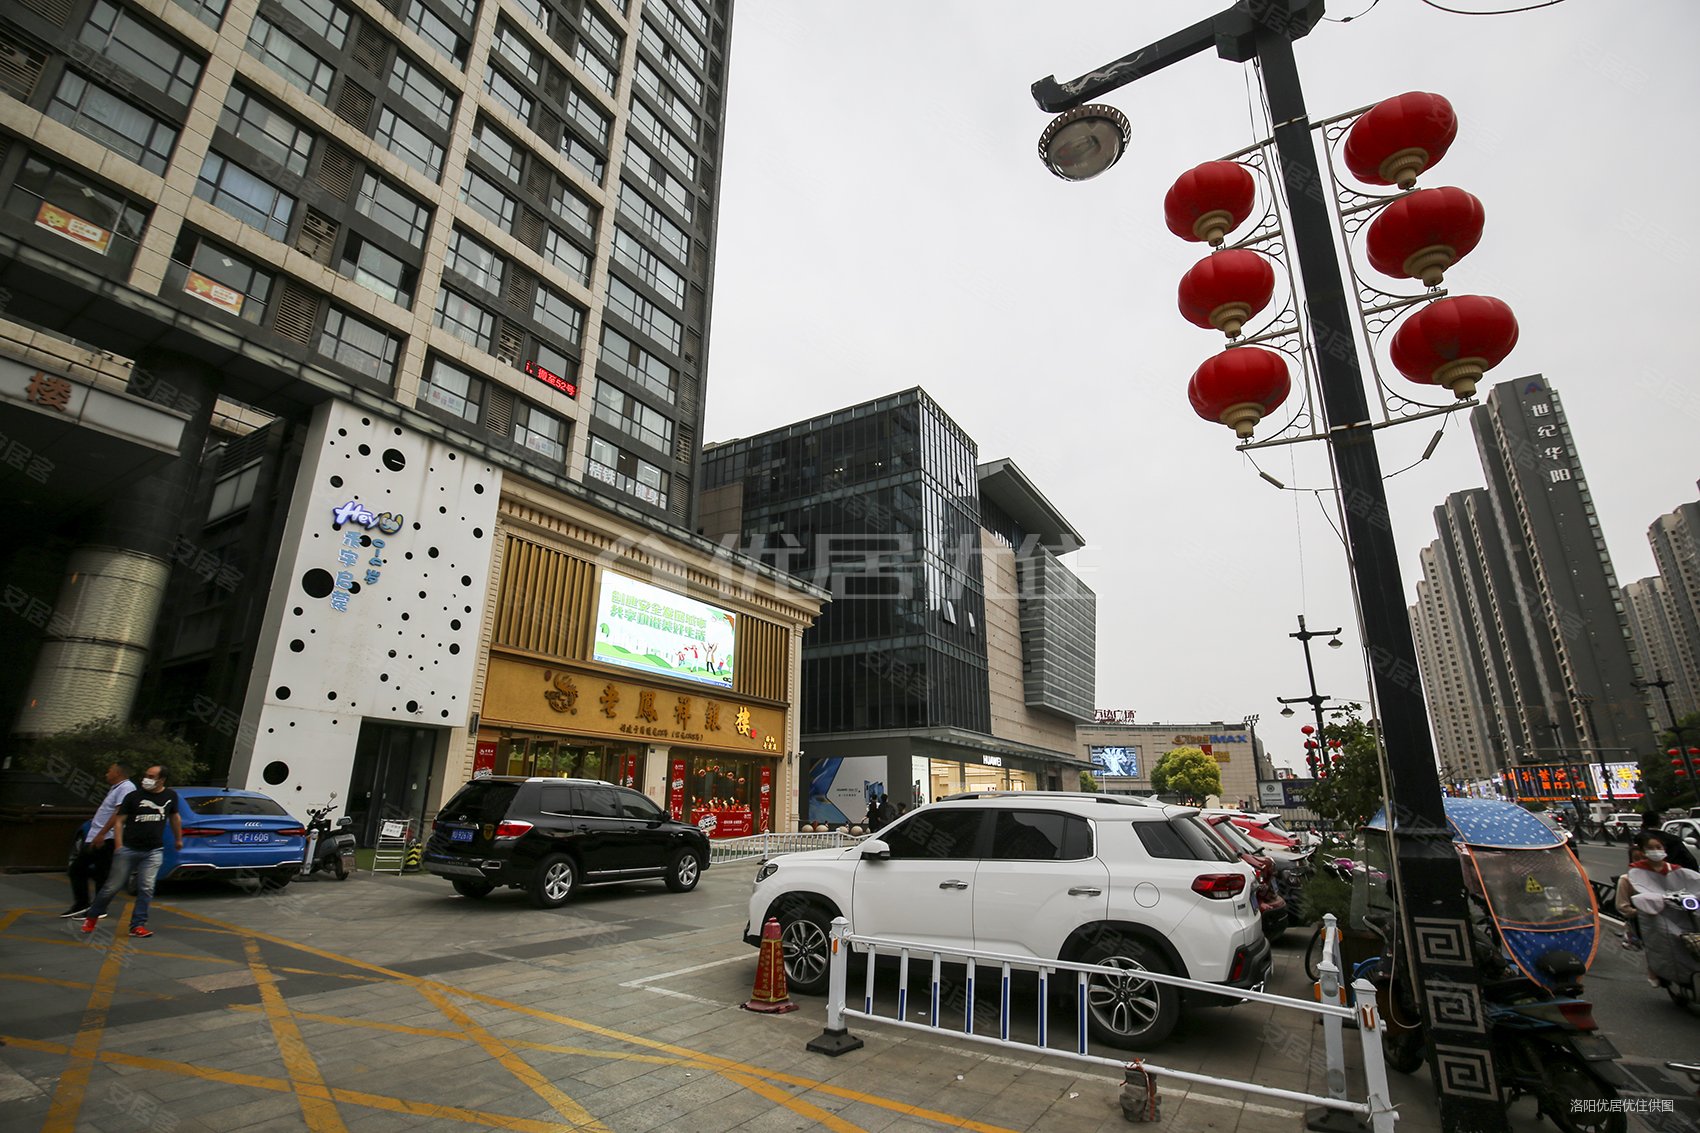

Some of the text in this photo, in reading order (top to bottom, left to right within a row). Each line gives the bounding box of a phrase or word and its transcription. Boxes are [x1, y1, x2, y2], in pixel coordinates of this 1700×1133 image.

[1531, 403, 1572, 483] 世纪华阳
[333, 501, 380, 531] Hey
